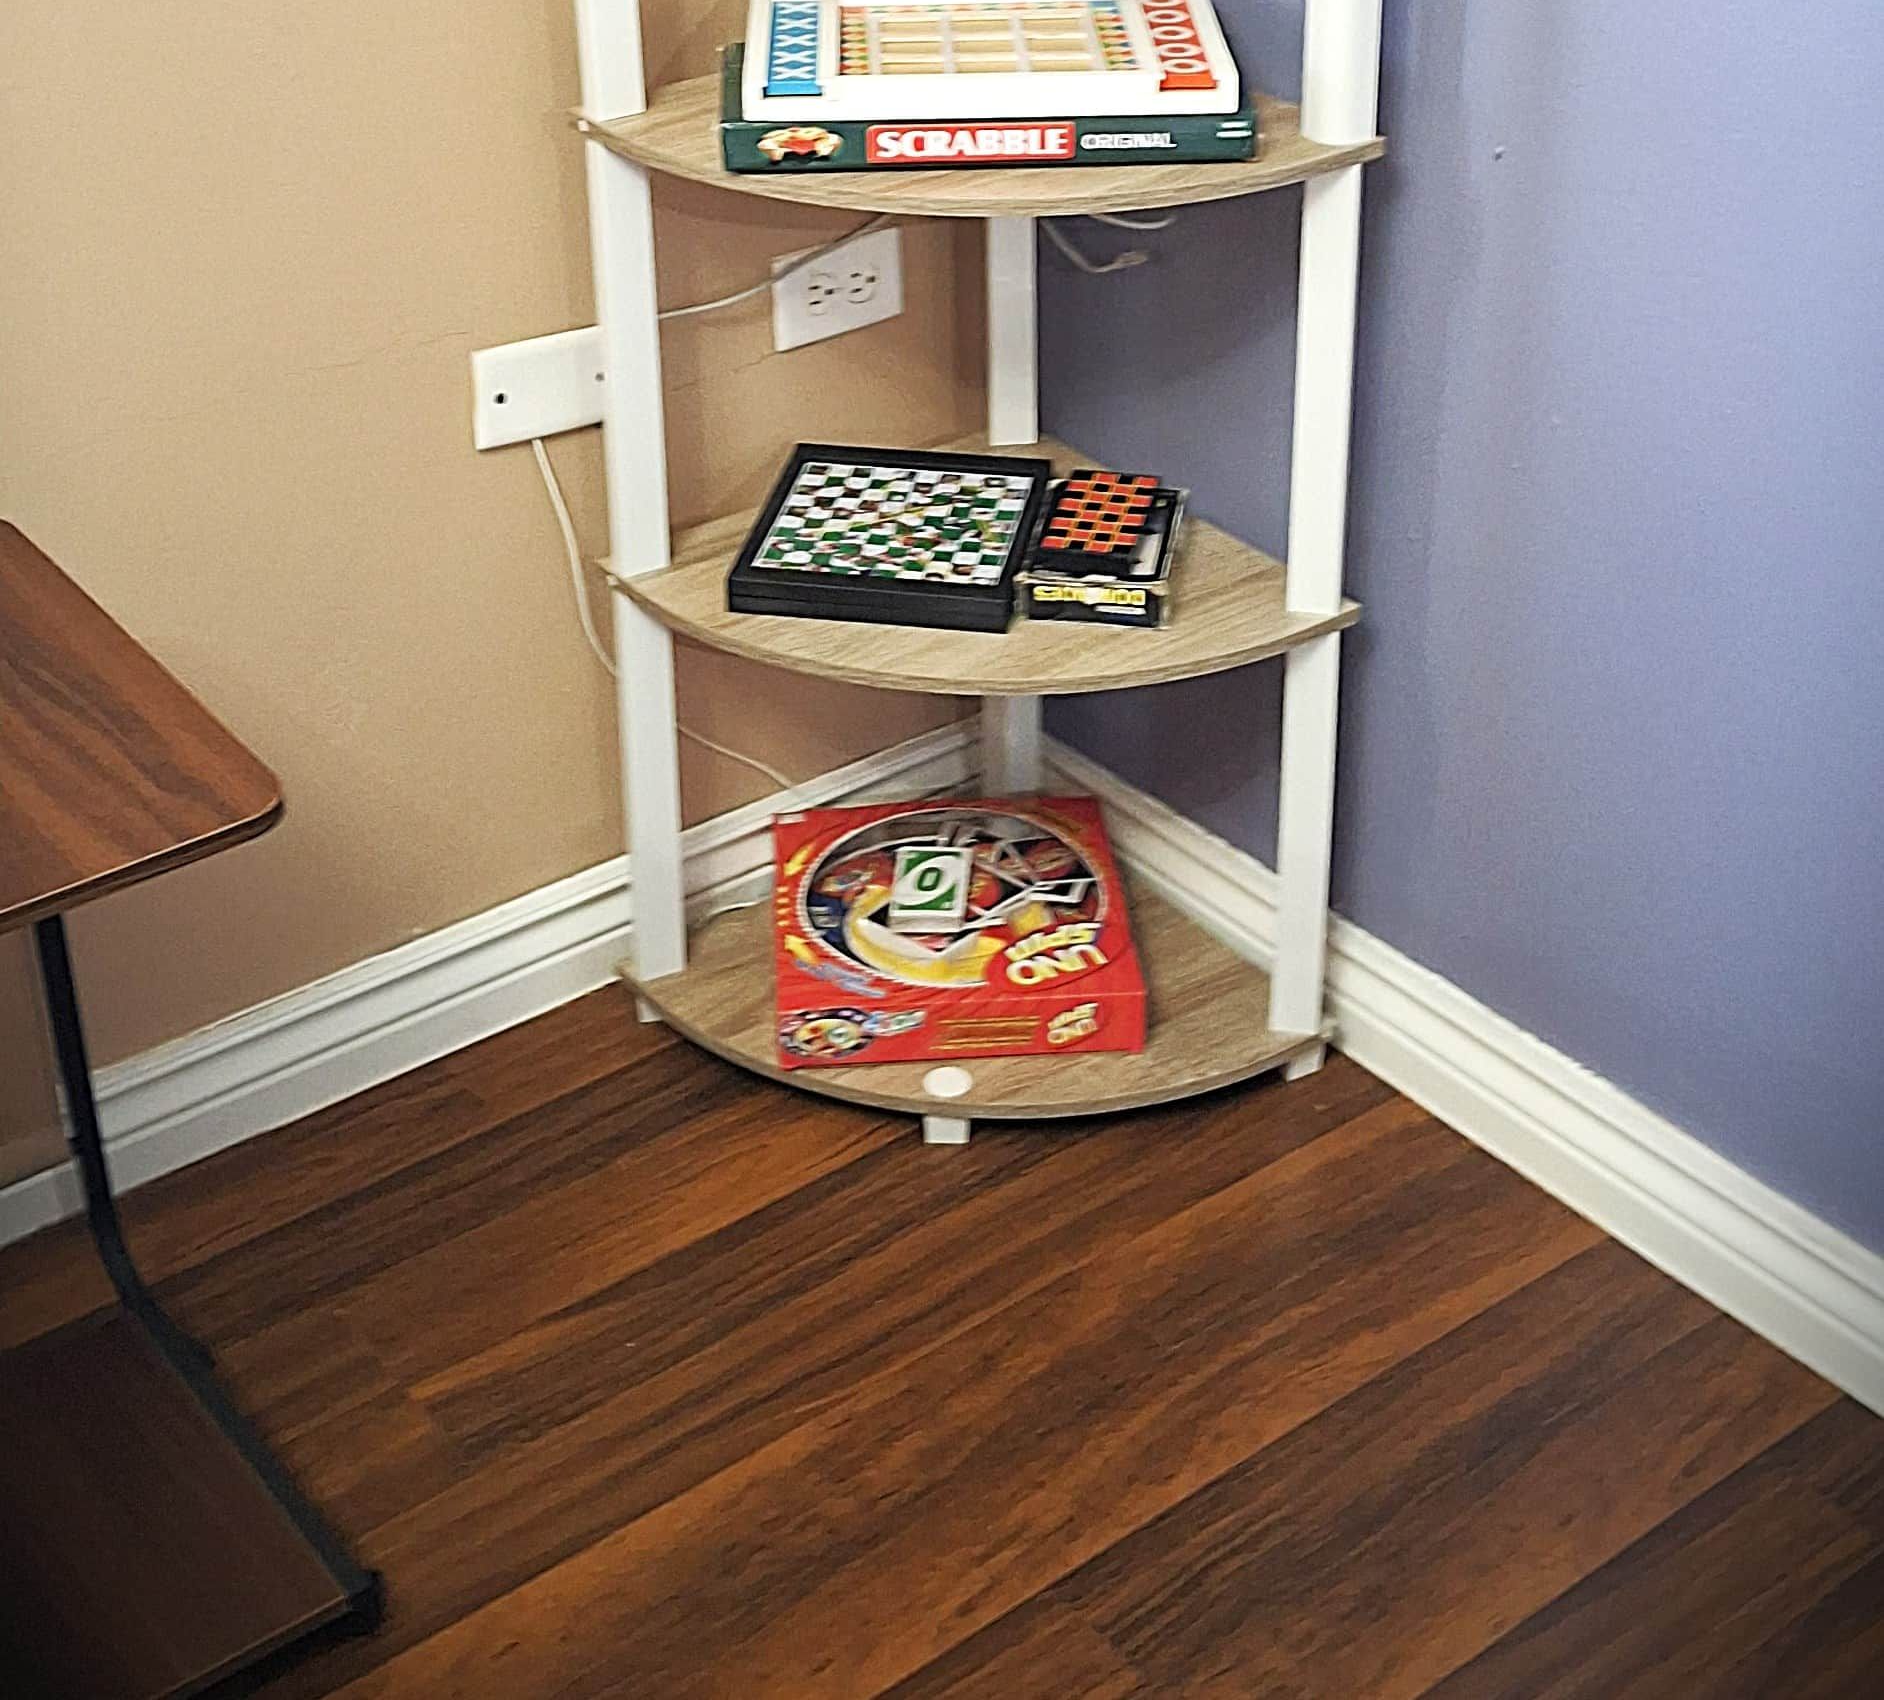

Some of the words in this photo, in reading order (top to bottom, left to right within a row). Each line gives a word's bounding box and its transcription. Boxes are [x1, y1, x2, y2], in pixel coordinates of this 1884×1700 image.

[876, 128, 1069, 158] SCRABBLE
[1080, 132, 1178, 150] ORIGINAL
[1005, 944, 1109, 985] UNO
